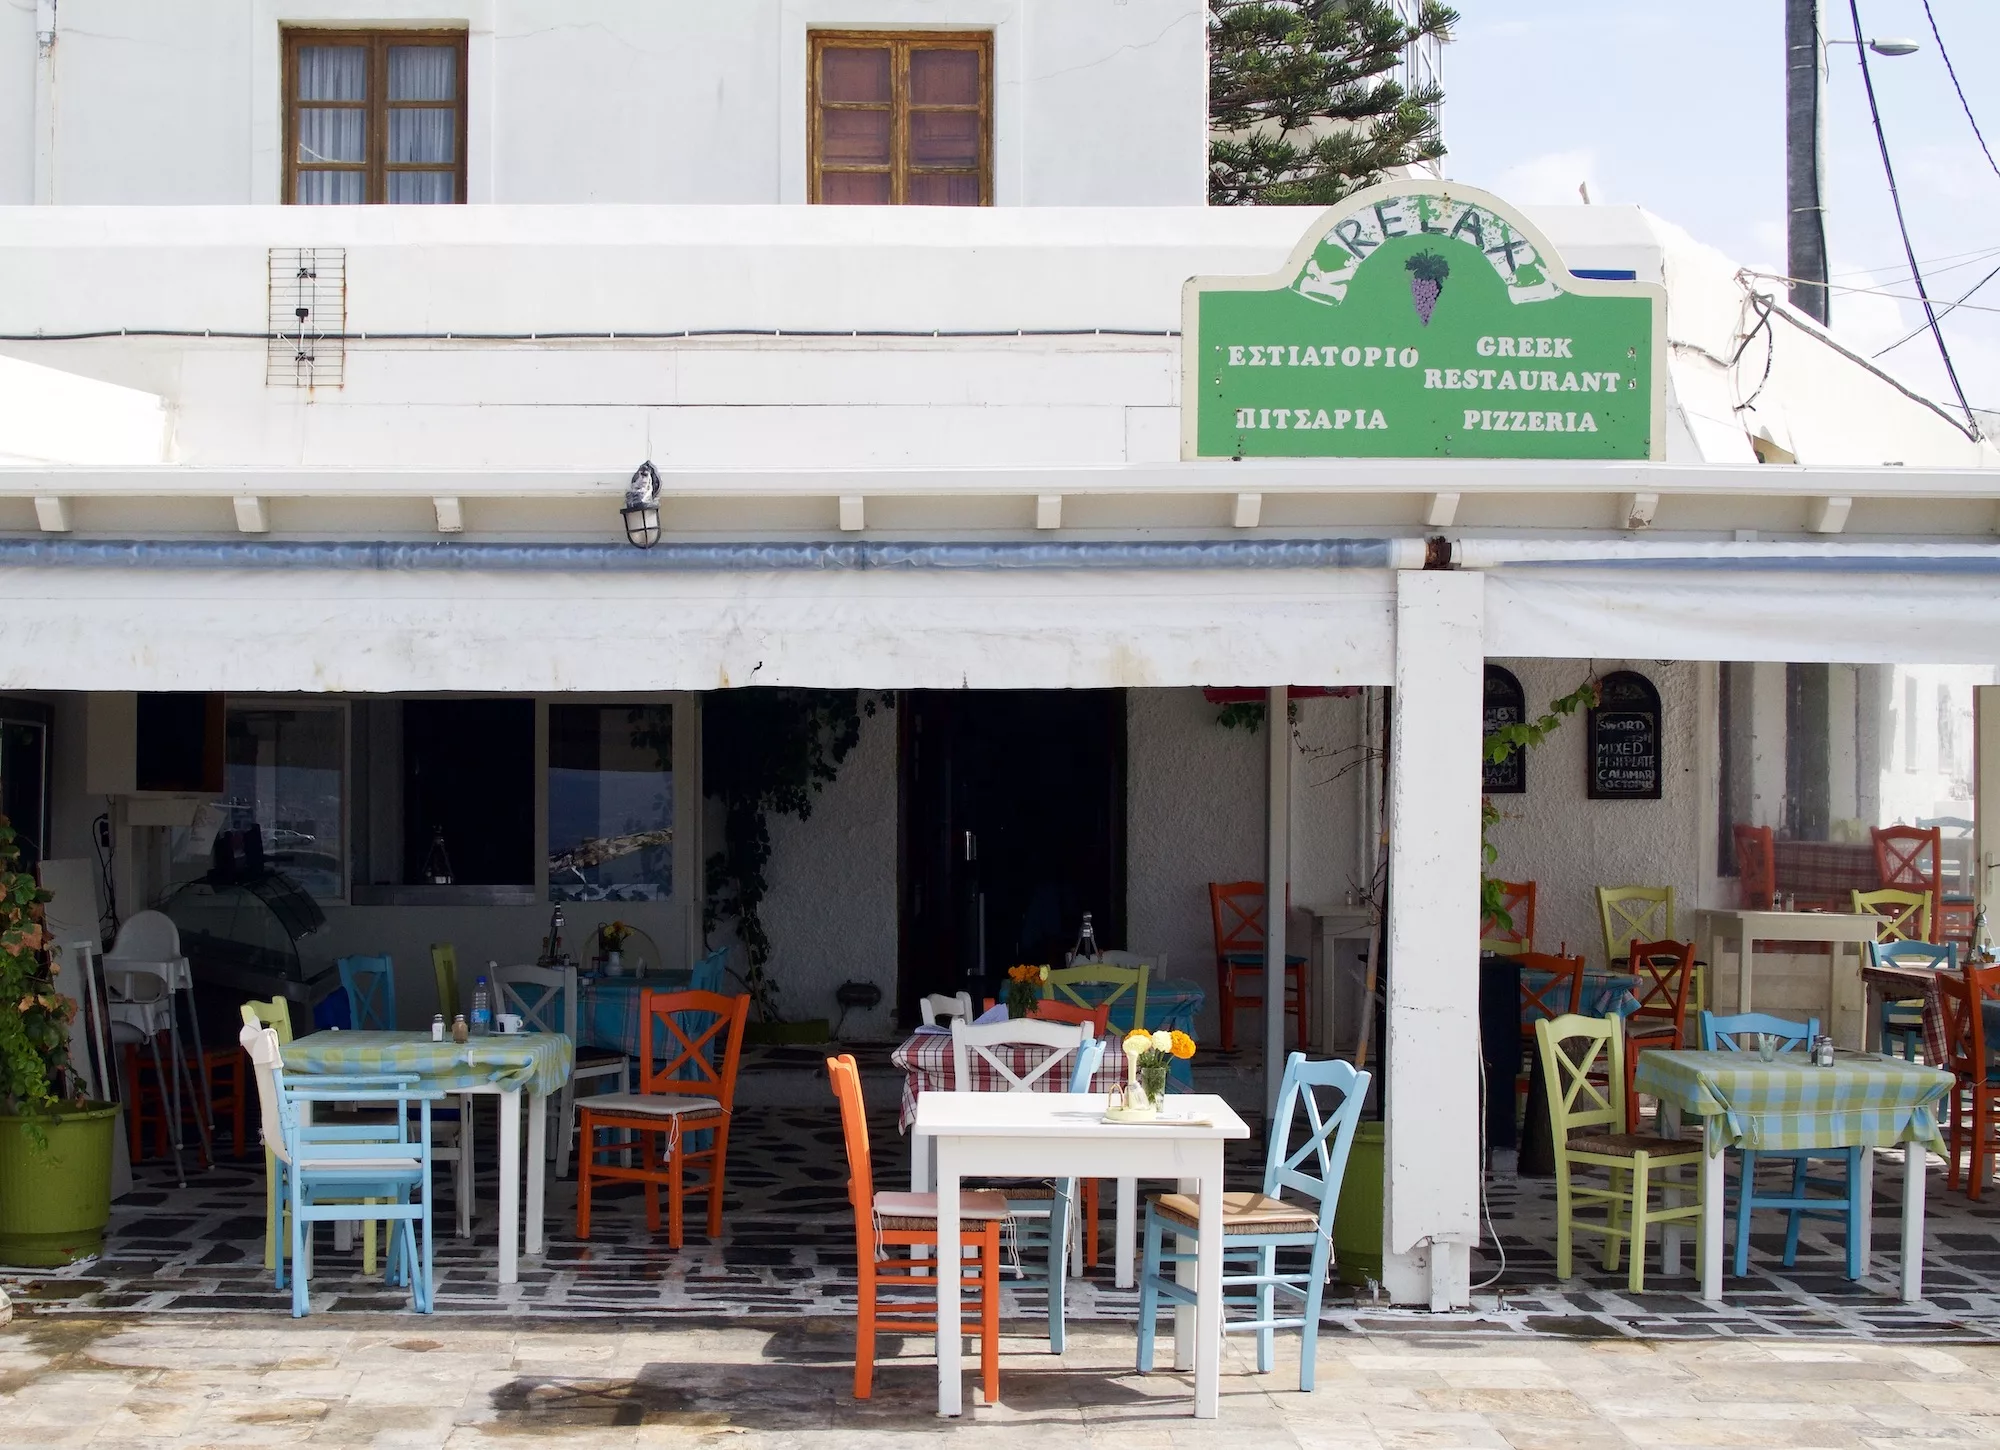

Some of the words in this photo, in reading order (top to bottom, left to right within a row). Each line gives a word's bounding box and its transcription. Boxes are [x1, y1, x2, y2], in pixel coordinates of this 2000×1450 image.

[1335, 199, 1528, 274] RELAX
[1228, 345, 1419, 368] ΕΣΤΙΑΤΟΡΙΟ
[1476, 336, 1573, 358] GREEK
[1424, 368, 1621, 393] RESTAURANT
[1235, 407, 1388, 430] ΠΙΤΣΑΡΙΑ
[1463, 409, 1598, 432] PIZZERIA
[1598, 720, 1646, 732] SWORD
[1598, 742, 1644, 755] MIXED
